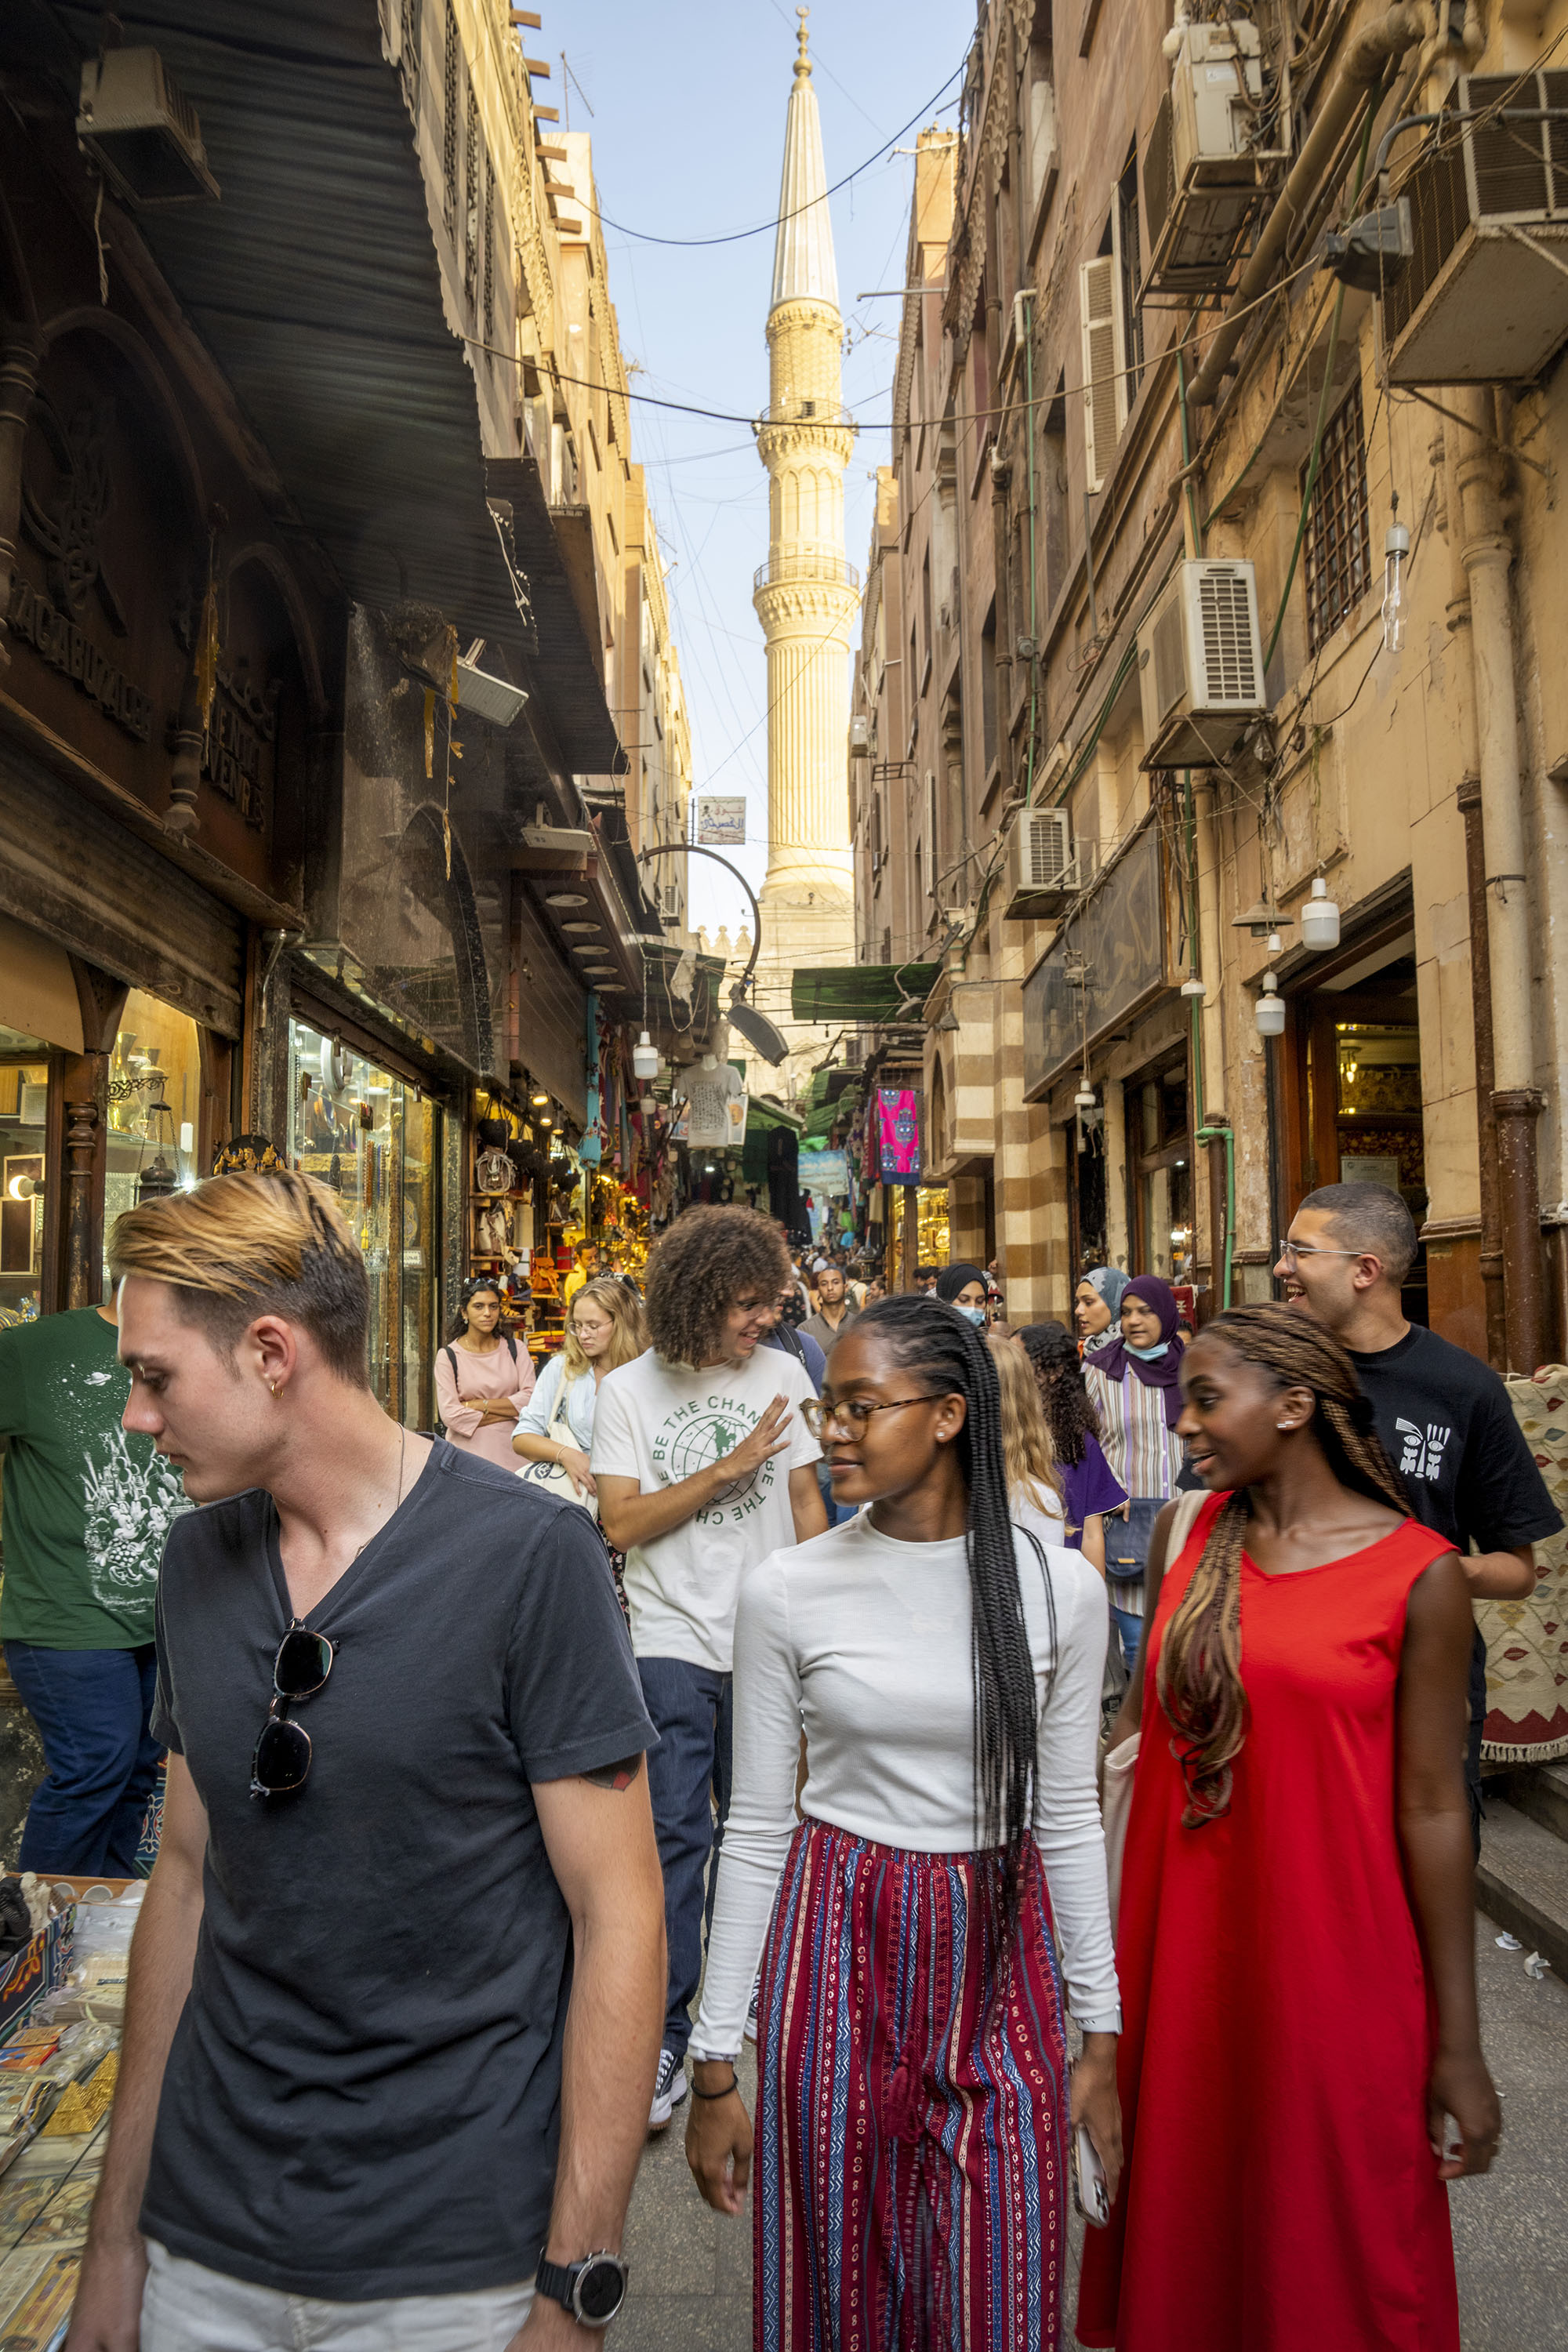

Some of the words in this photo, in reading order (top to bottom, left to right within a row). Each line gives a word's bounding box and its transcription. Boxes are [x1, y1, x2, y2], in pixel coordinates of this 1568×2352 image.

[653, 1435, 670, 1461] BE
[663, 1400, 701, 1430] THE
[707, 1396, 761, 1425] CHAN
[762, 1460, 775, 1486] BE
[731, 1491, 767, 1521] THE
